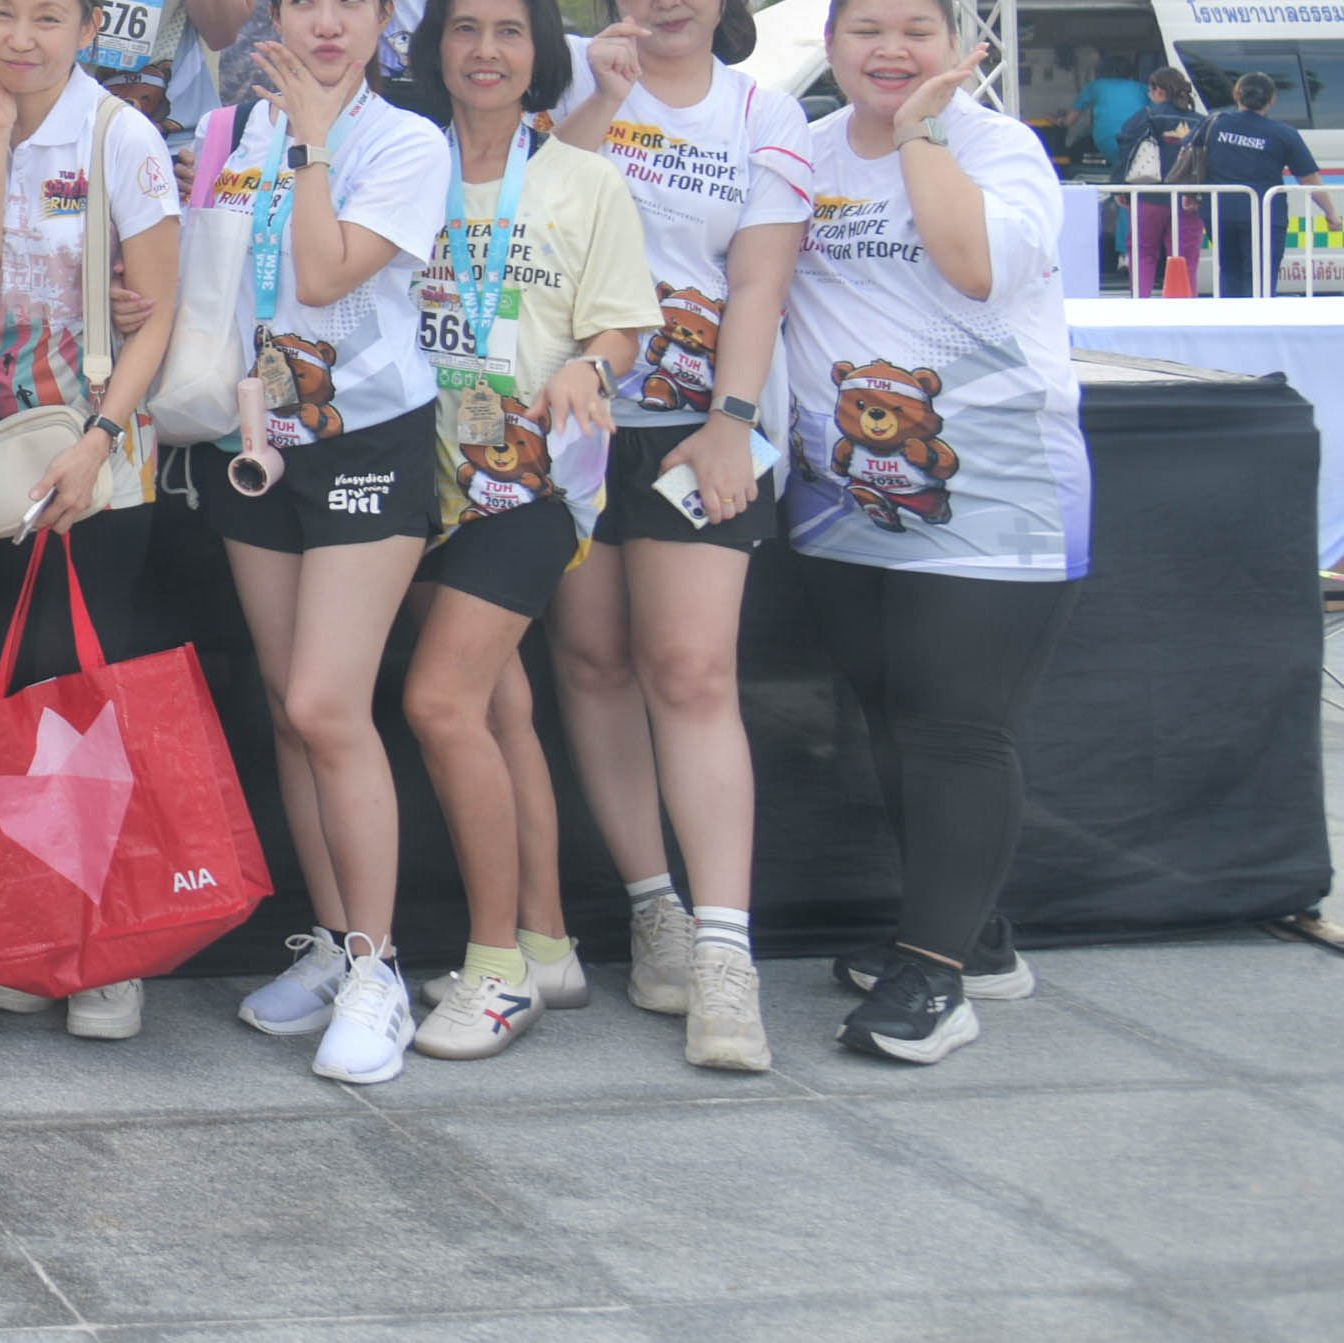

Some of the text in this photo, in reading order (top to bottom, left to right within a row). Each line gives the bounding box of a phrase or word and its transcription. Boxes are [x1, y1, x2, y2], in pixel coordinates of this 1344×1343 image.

[631, 131, 664, 150] FOR
[1217, 130, 1266, 151] NURSE
[611, 141, 738, 181] RUN FOR HOPE
[624, 163, 702, 194] RUN FOR
[219, 191, 250, 207] RUN
[817, 218, 889, 239] FOR HOPE
[856, 240, 924, 264] PEOPLE
[261, 248, 279, 291] 3KM.
[502, 265, 562, 290] PEOPLE
[679, 354, 702, 371] TUH
[866, 378, 892, 391] TUH
[270, 418, 295, 433] TUH
[866, 457, 899, 473] TUH
[485, 481, 514, 494] TUH
[172, 866, 217, 894] AIA
